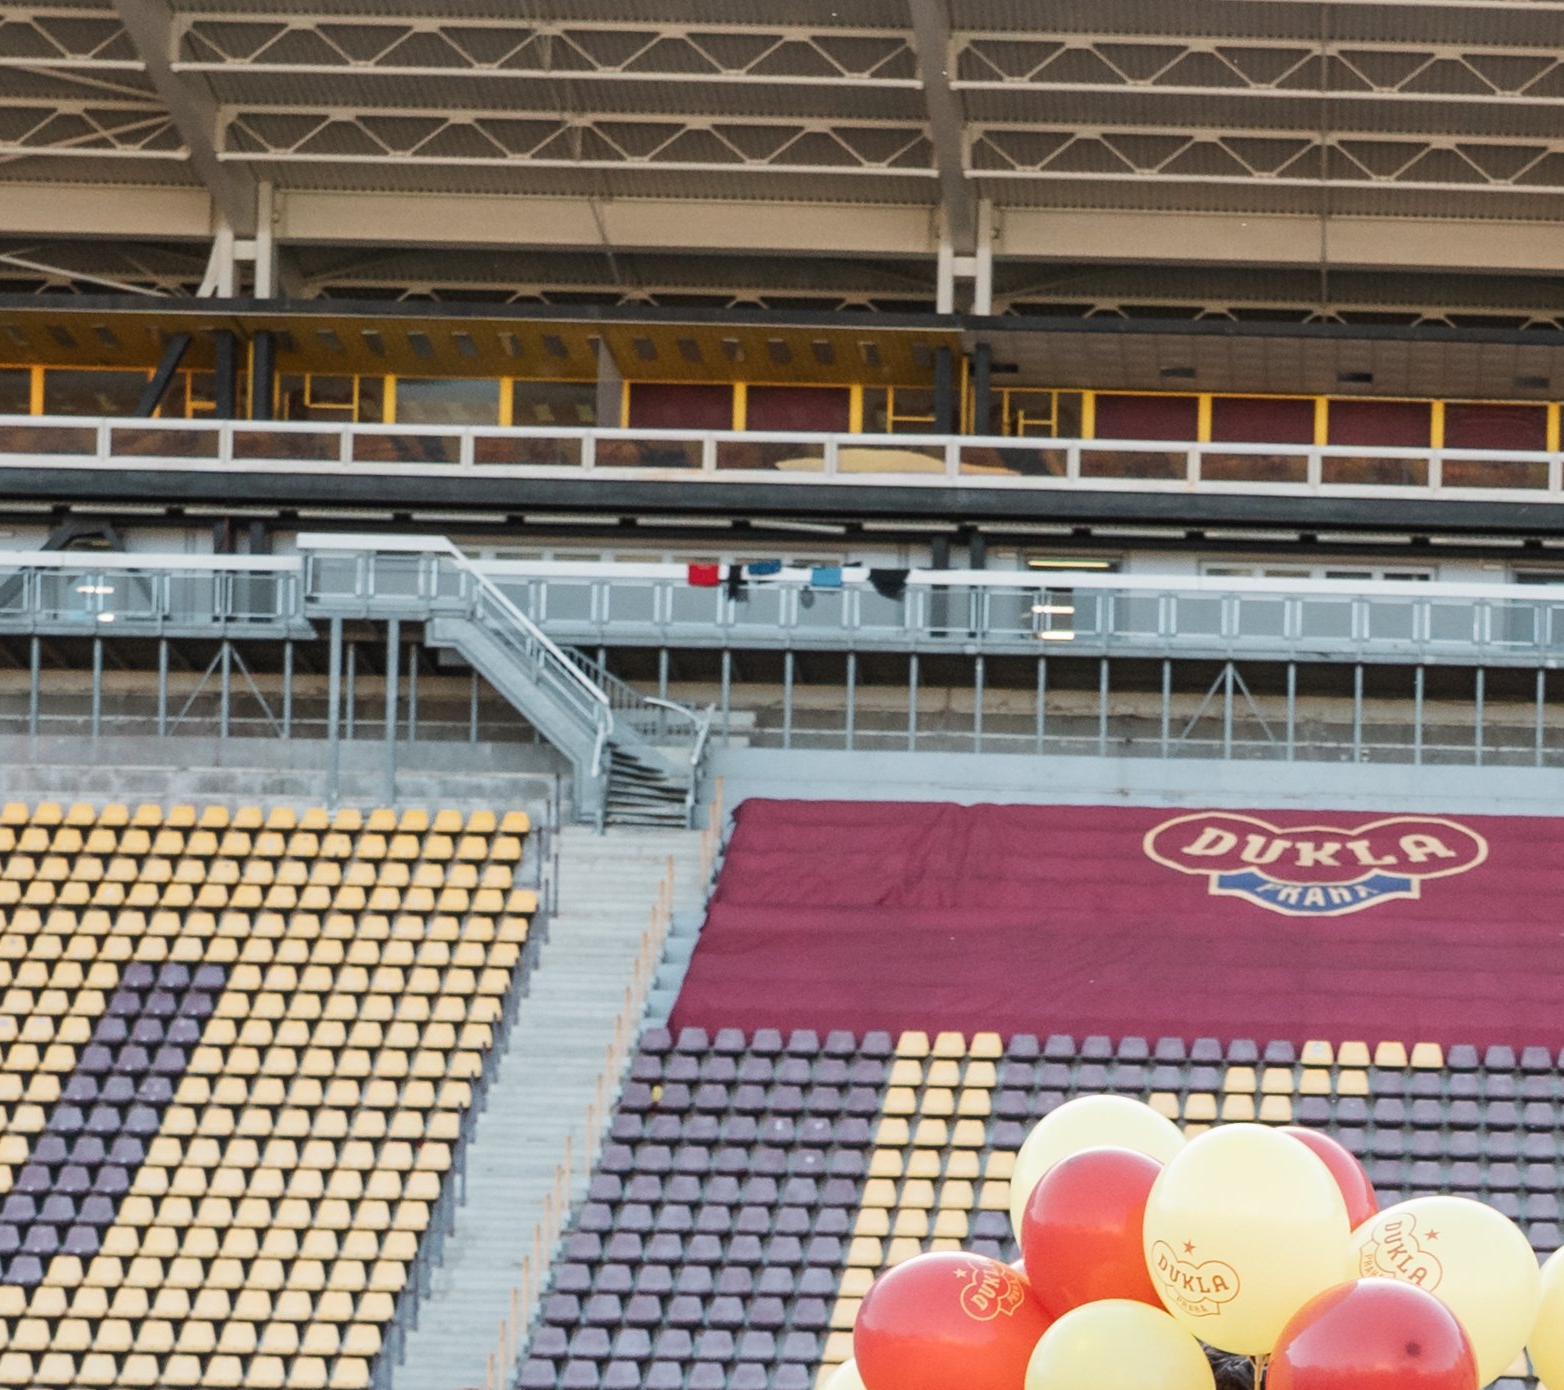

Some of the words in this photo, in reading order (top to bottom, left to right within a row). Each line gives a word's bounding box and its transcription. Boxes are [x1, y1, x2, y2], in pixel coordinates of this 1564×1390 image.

[1182, 827, 1456, 867] DUKLA
[1256, 884, 1379, 907] PRAHA
[1384, 1221, 1427, 1286] DUKLA
[1157, 1255, 1231, 1294] DUKLA
